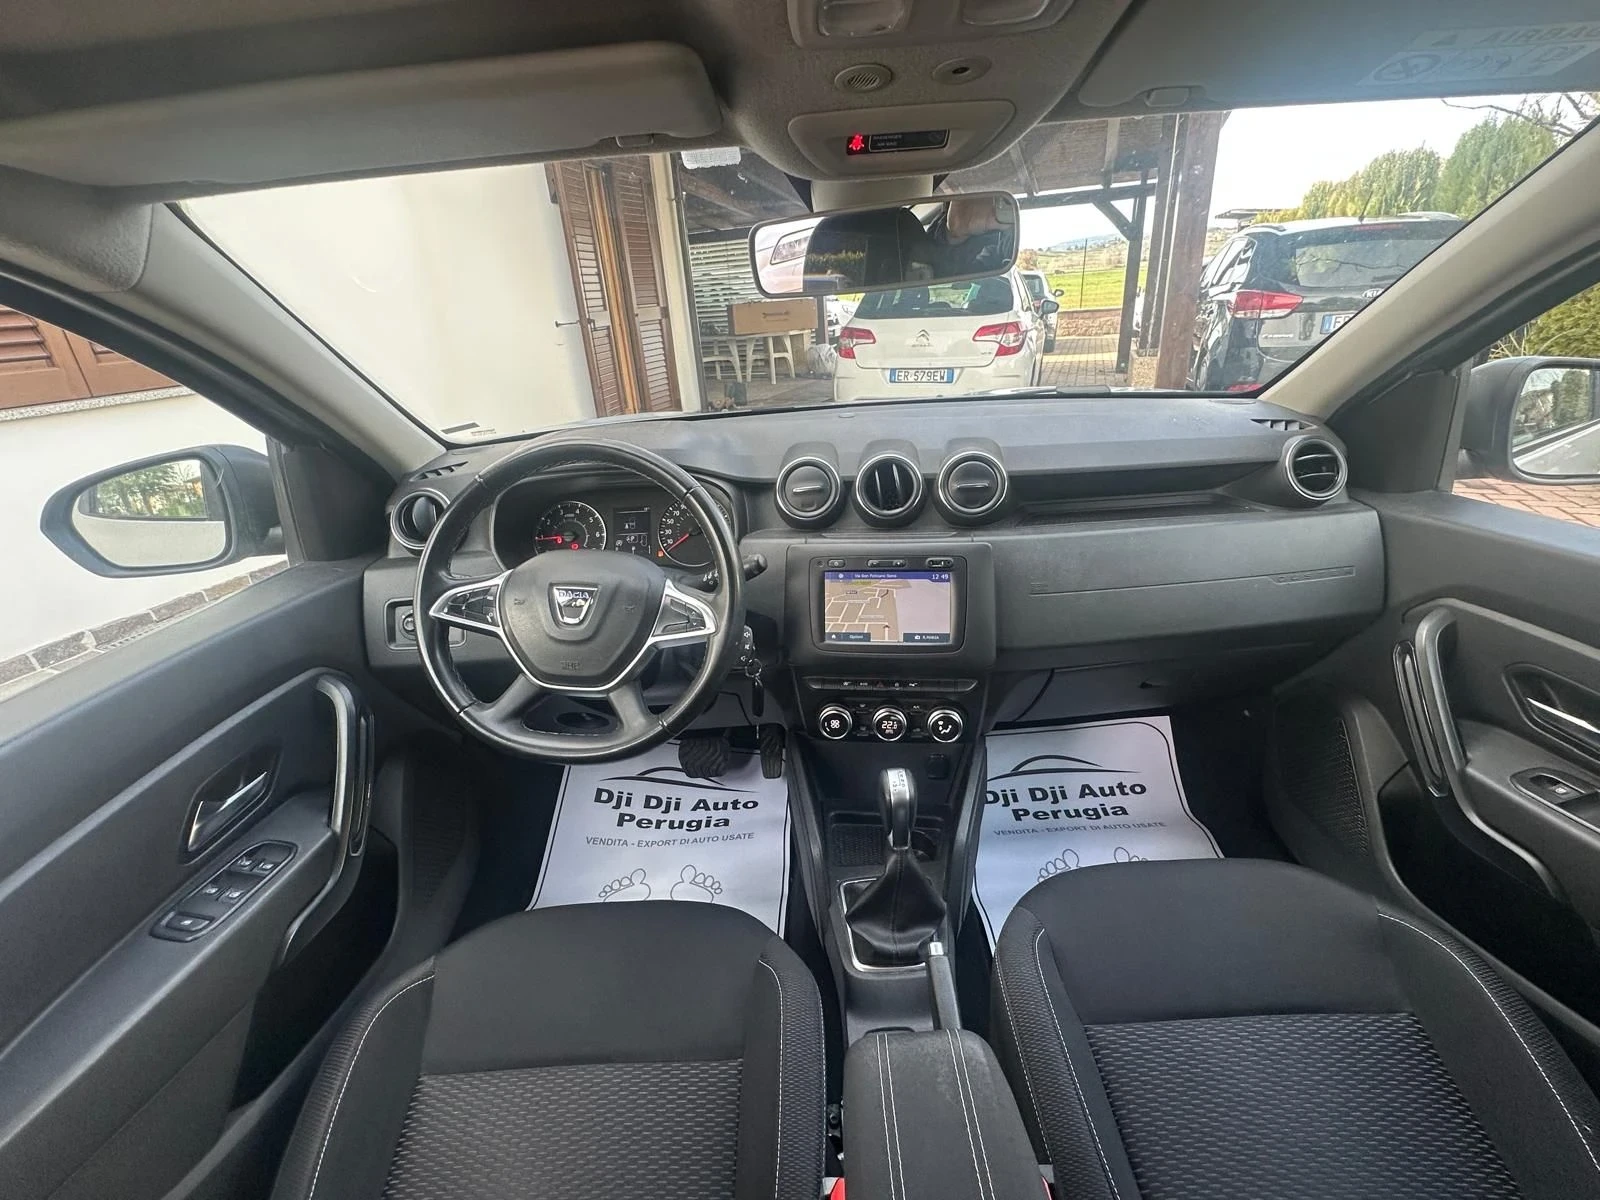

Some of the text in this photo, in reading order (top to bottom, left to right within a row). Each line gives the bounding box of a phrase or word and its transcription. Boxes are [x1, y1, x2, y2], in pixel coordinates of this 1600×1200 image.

[896, 370, 946, 381] ER 579EW
[558, 590, 590, 599] DACIA
[594, 787, 759, 814] Dji Dji Auto
[985, 781, 1147, 807] Dji Dji Auto
[1012, 803, 1129, 822] Perugia
[616, 812, 730, 832] Perugia
[993, 827, 1039, 836] VENDITA
[1044, 825, 1087, 833] EXPORT
[1132, 821, 1167, 829] USATE
[585, 836, 629, 847] VENDITA
[637, 838, 678, 848] EXPORT
[679, 837, 690, 845] DI
[692, 834, 719, 844] AUTO
[721, 832, 756, 842] USATE
